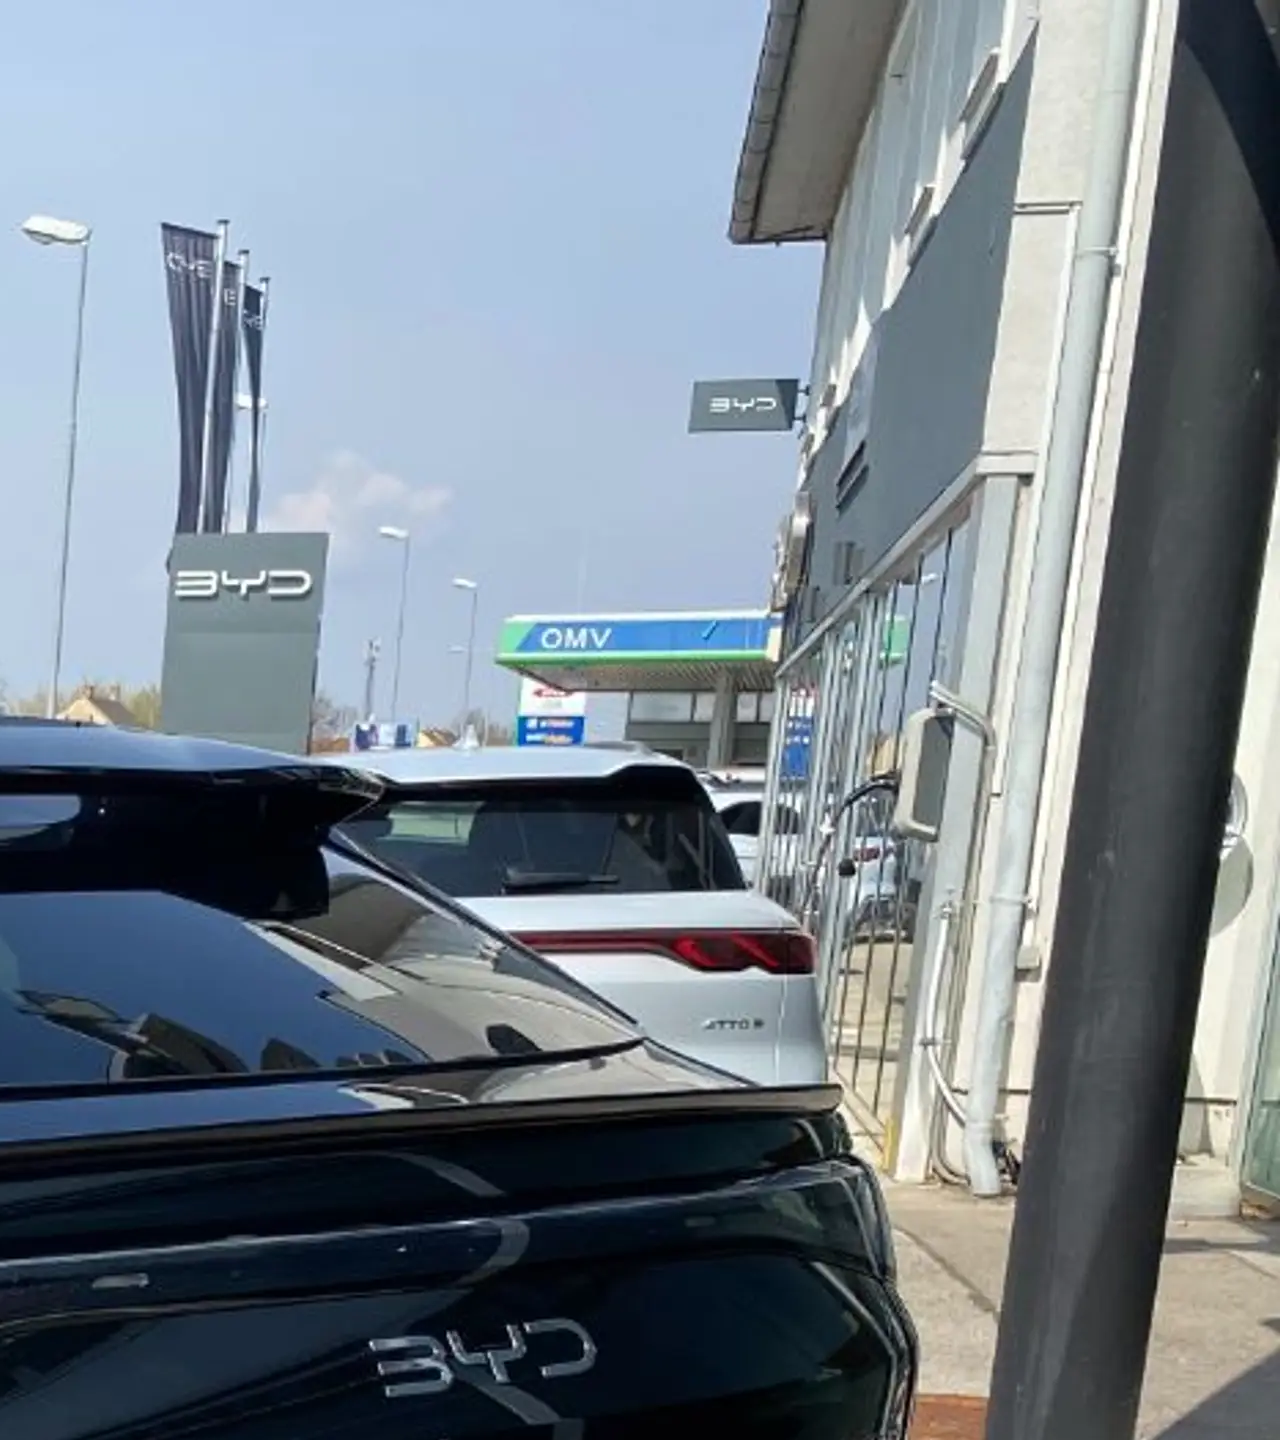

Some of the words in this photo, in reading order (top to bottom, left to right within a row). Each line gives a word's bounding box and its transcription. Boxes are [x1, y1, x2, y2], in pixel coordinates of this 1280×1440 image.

[708, 397, 777, 413] BYD
[175, 570, 312, 597] BYD
[541, 628, 612, 649] OMV
[370, 1317, 598, 1397] BYD
